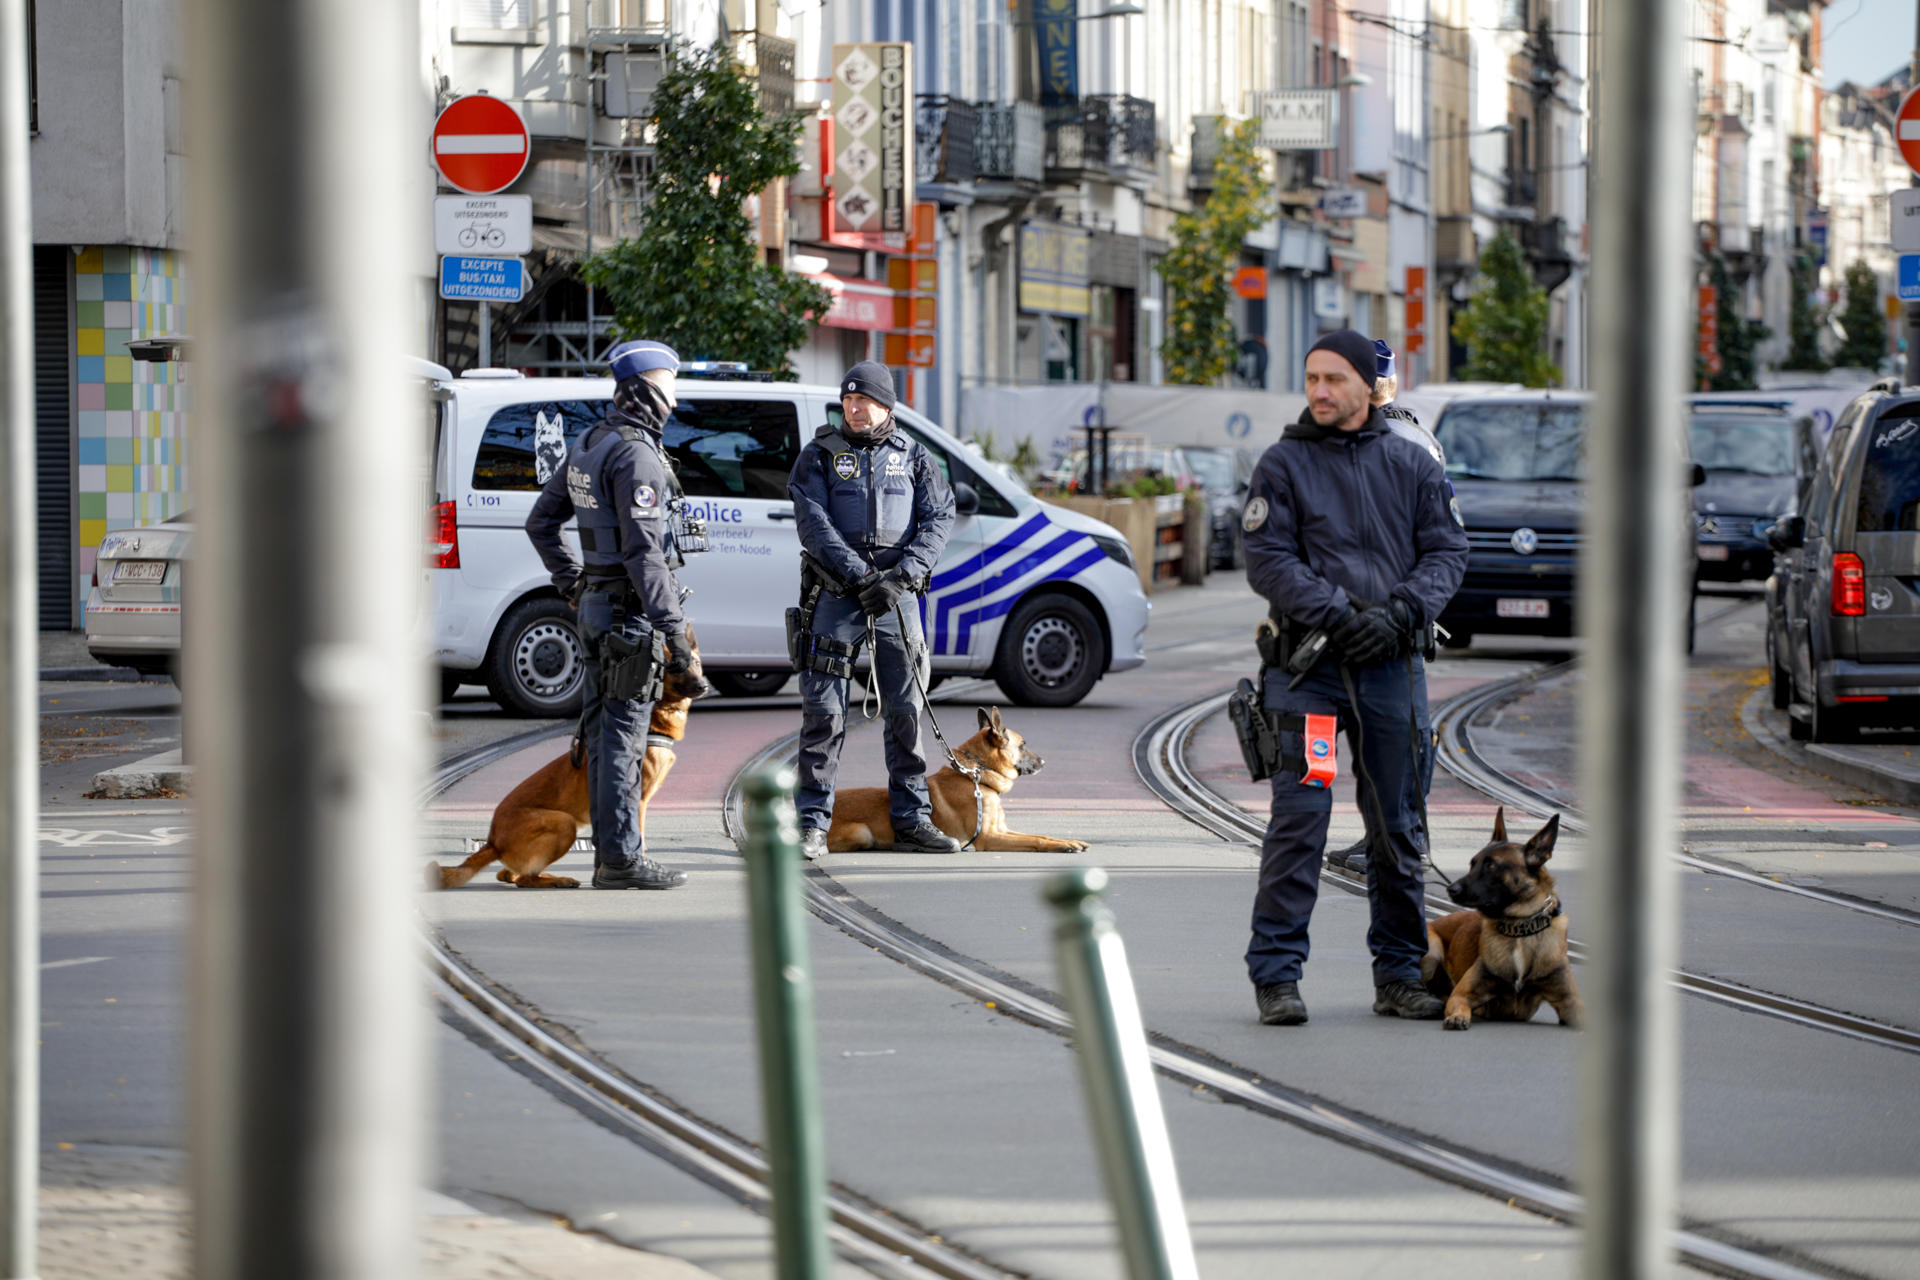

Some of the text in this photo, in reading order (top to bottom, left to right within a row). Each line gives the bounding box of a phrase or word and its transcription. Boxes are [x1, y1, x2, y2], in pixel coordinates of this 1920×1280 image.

[881, 47, 903, 230] BOUCHERIE
[455, 211, 508, 219] UITGEZONDERD
[461, 260, 504, 271] EXCEPTE
[459, 272, 506, 284] BUS/TAXI
[444, 284, 519, 298] UITGEZONDERD
[481, 496, 500, 506] 101
[681, 501, 743, 523] Police
